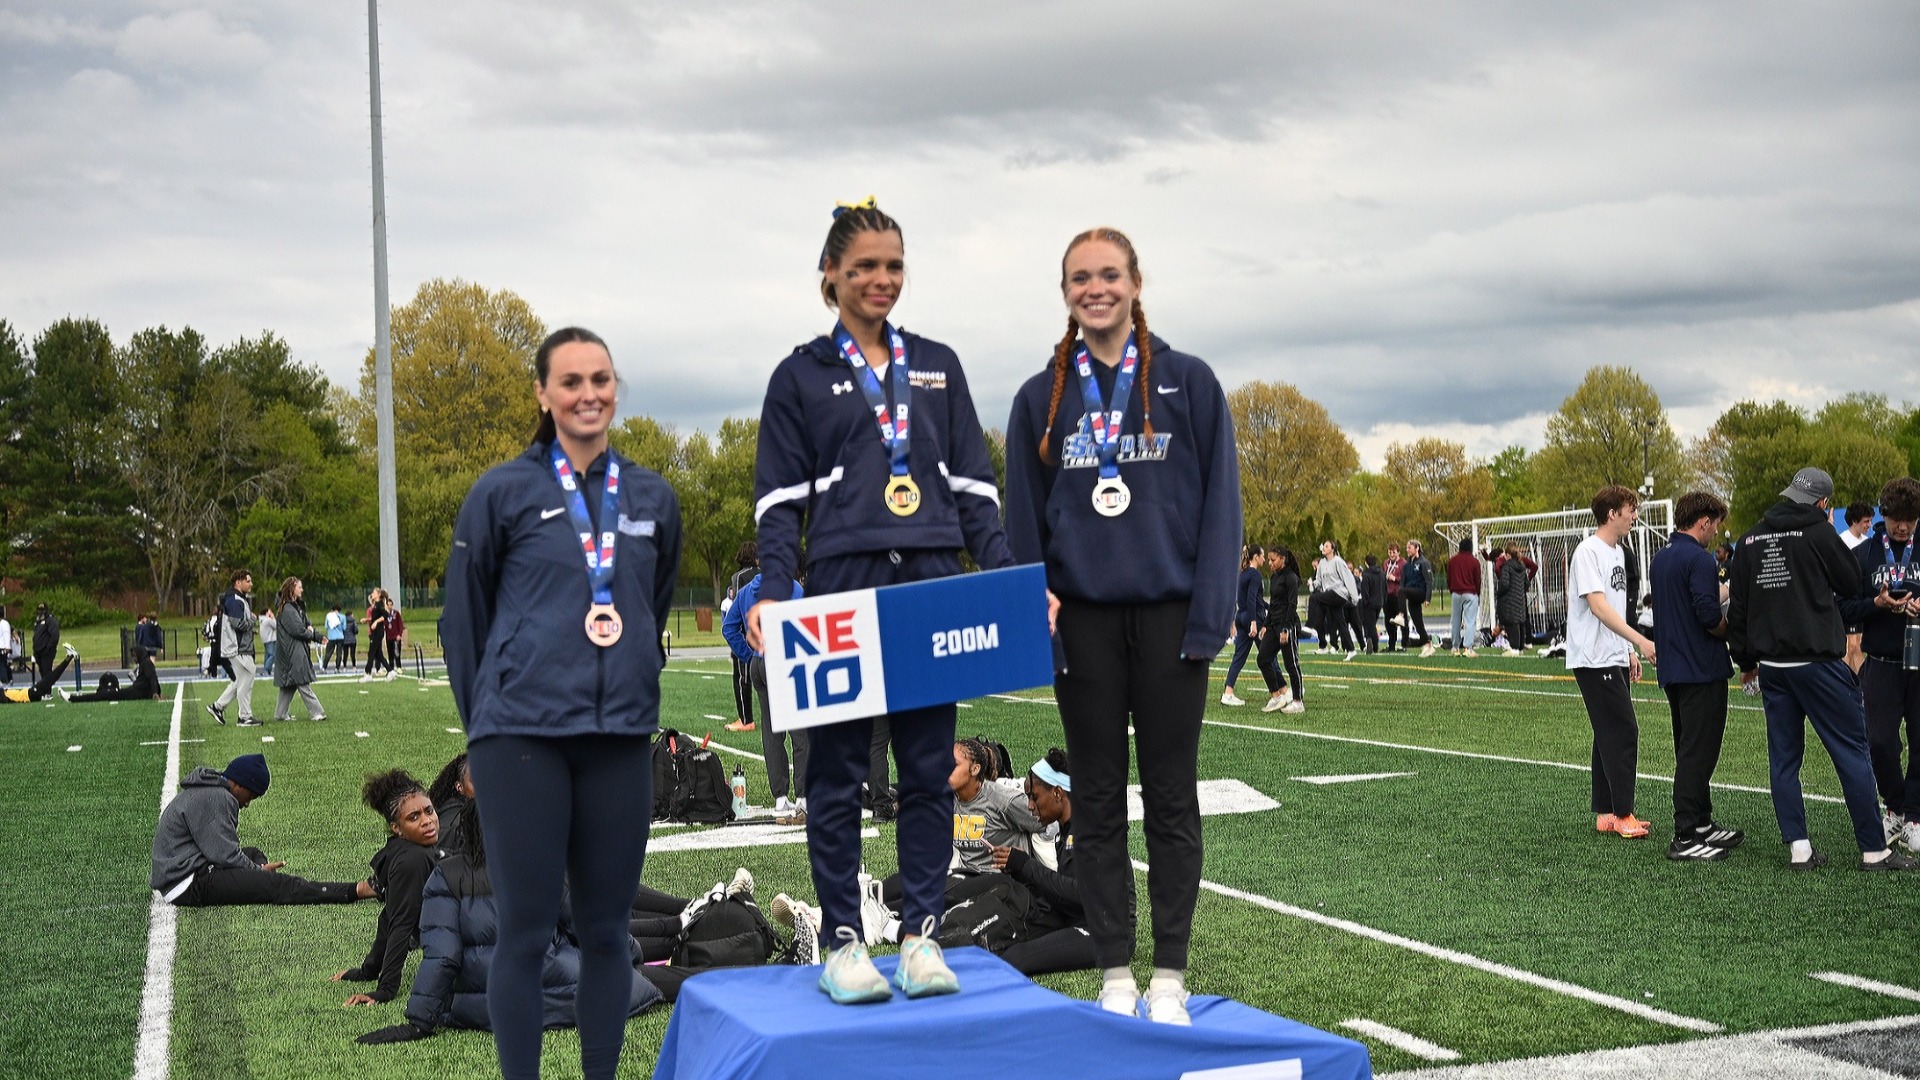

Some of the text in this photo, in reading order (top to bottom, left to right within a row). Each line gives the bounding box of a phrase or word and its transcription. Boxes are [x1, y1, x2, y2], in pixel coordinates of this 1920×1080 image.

[781, 609, 860, 660] NE
[932, 622, 999, 658] 200M
[788, 655, 863, 711] 10
